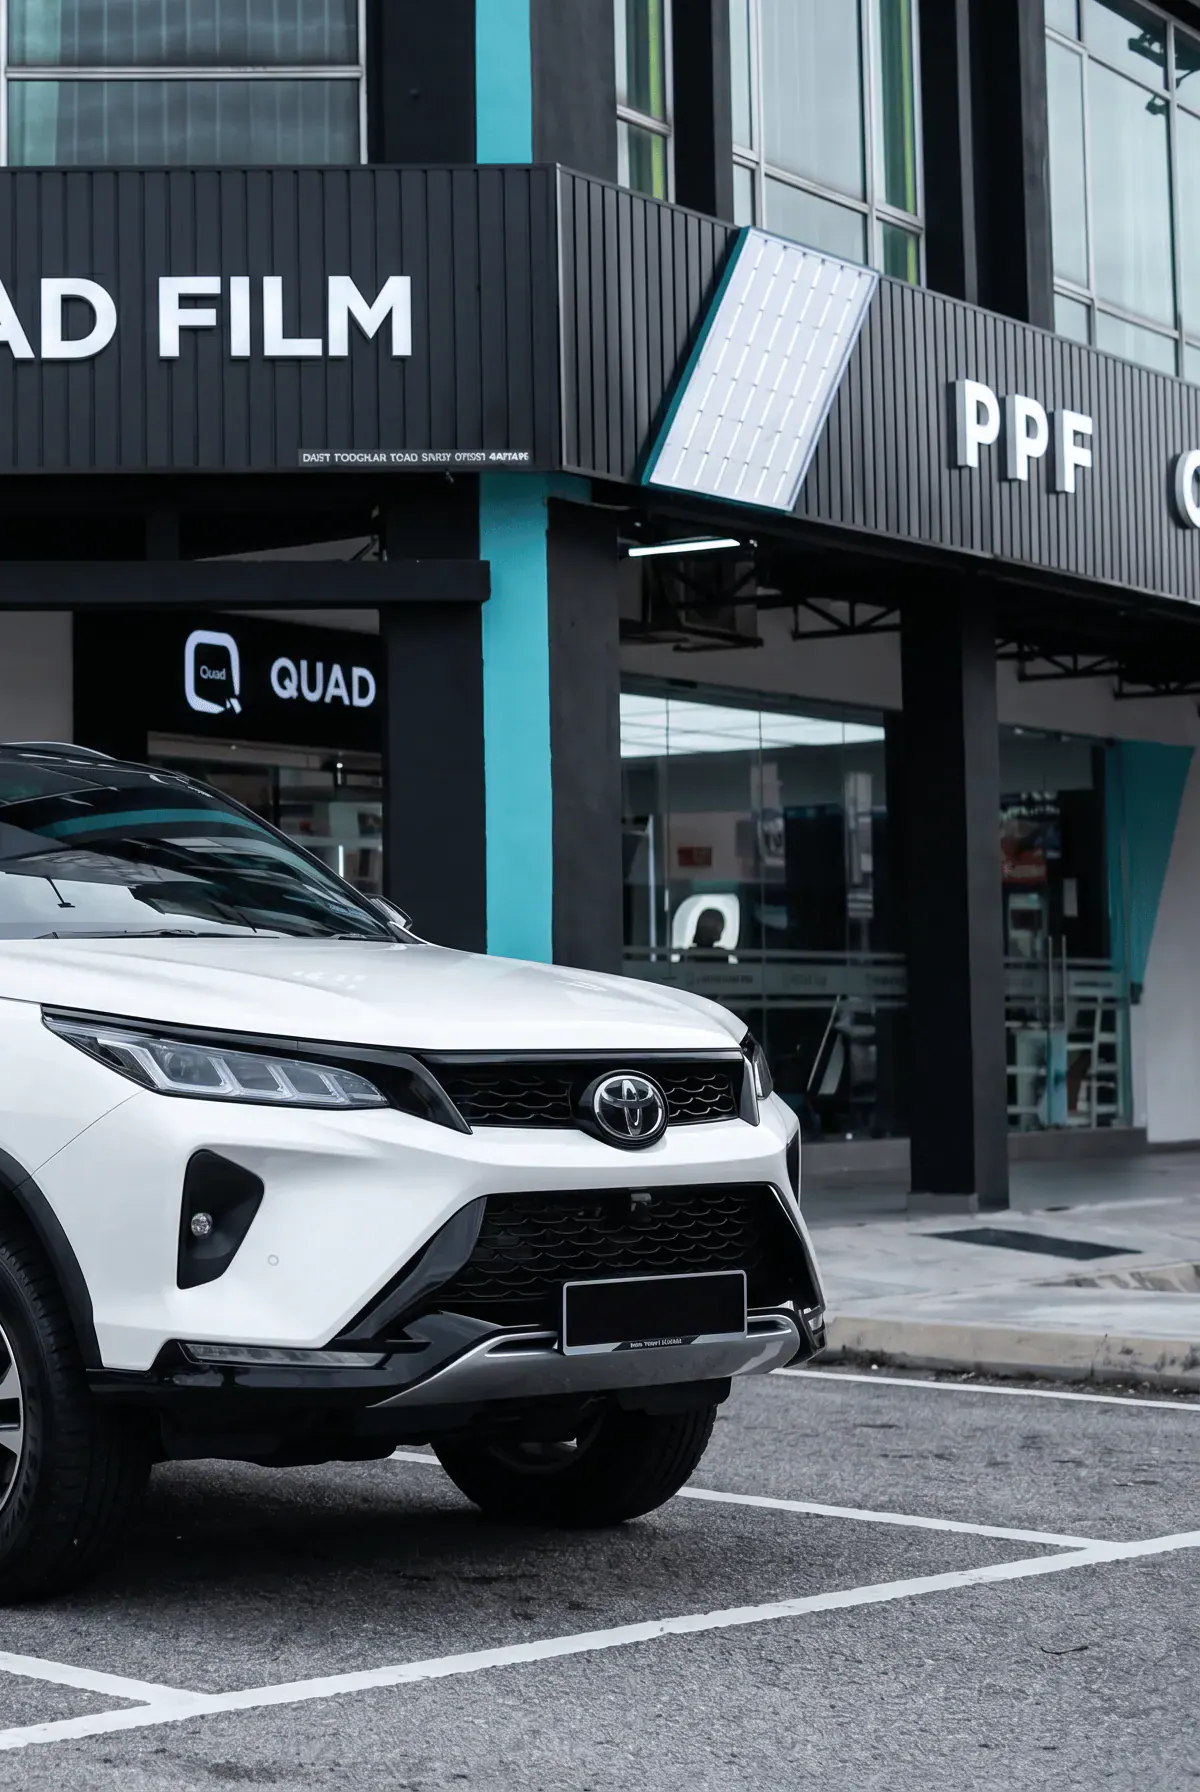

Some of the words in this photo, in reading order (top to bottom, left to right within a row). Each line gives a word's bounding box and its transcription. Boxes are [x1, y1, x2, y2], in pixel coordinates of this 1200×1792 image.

[158, 275, 413, 358] FILM
[956, 378, 1093, 494] PPF
[200, 665, 227, 680] Quad
[270, 656, 377, 708] QUAD
